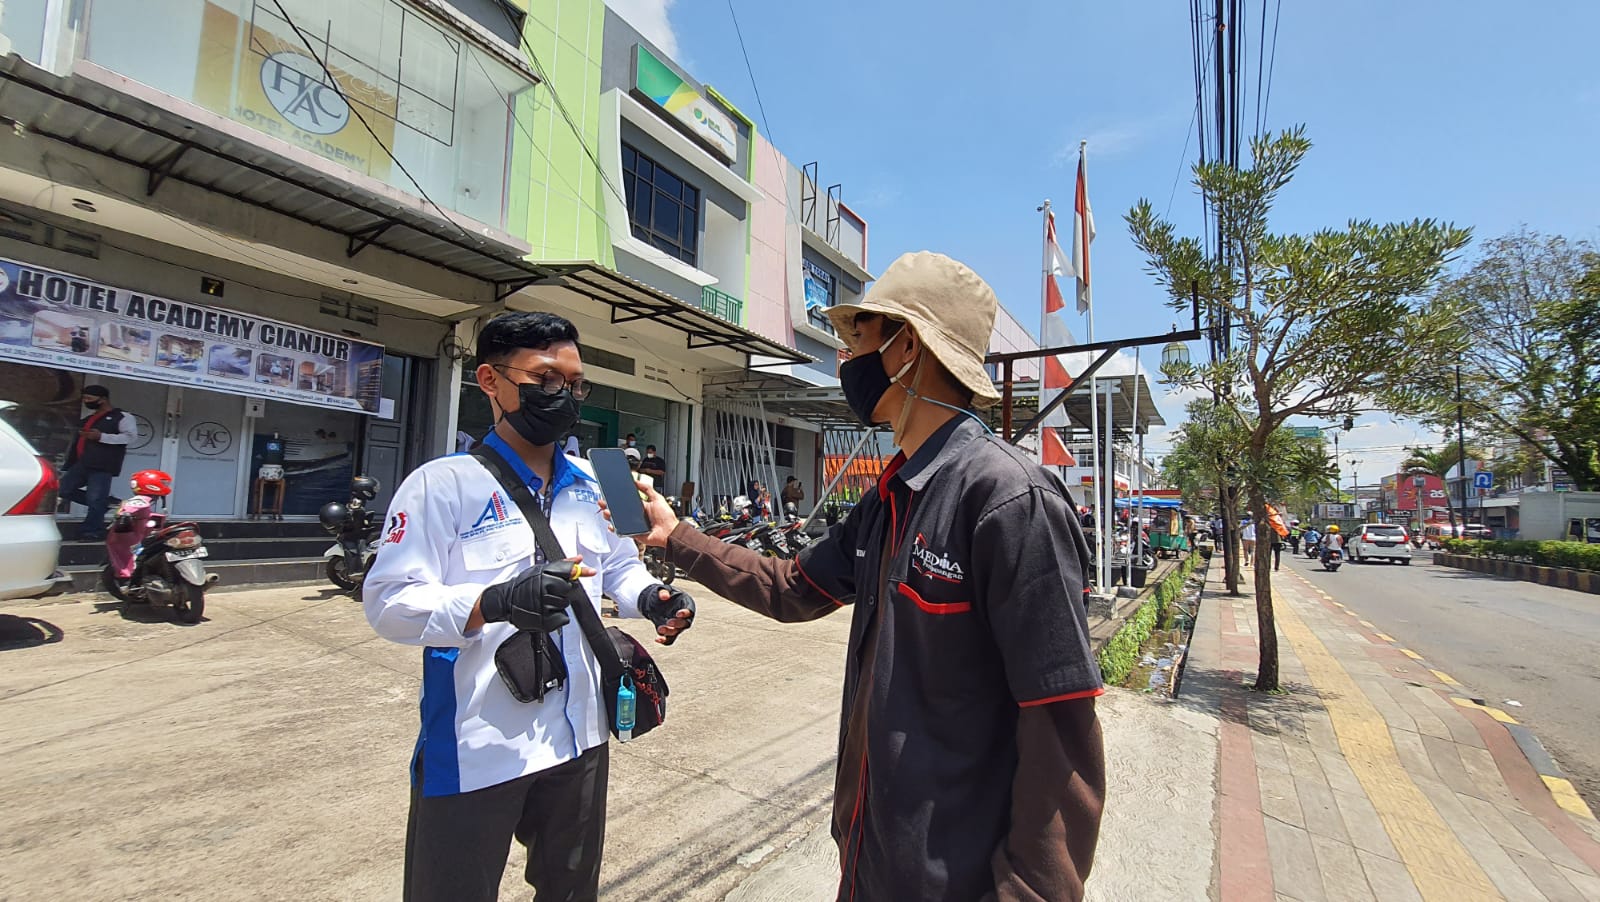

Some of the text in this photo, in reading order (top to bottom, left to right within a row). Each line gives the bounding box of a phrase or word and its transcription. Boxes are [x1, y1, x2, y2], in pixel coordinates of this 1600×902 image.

[291, 130, 366, 165] ACADEMY
[17, 269, 121, 314] HOTEL
[125, 294, 256, 341] ACADEMY
[259, 323, 350, 361] CIANJUR
